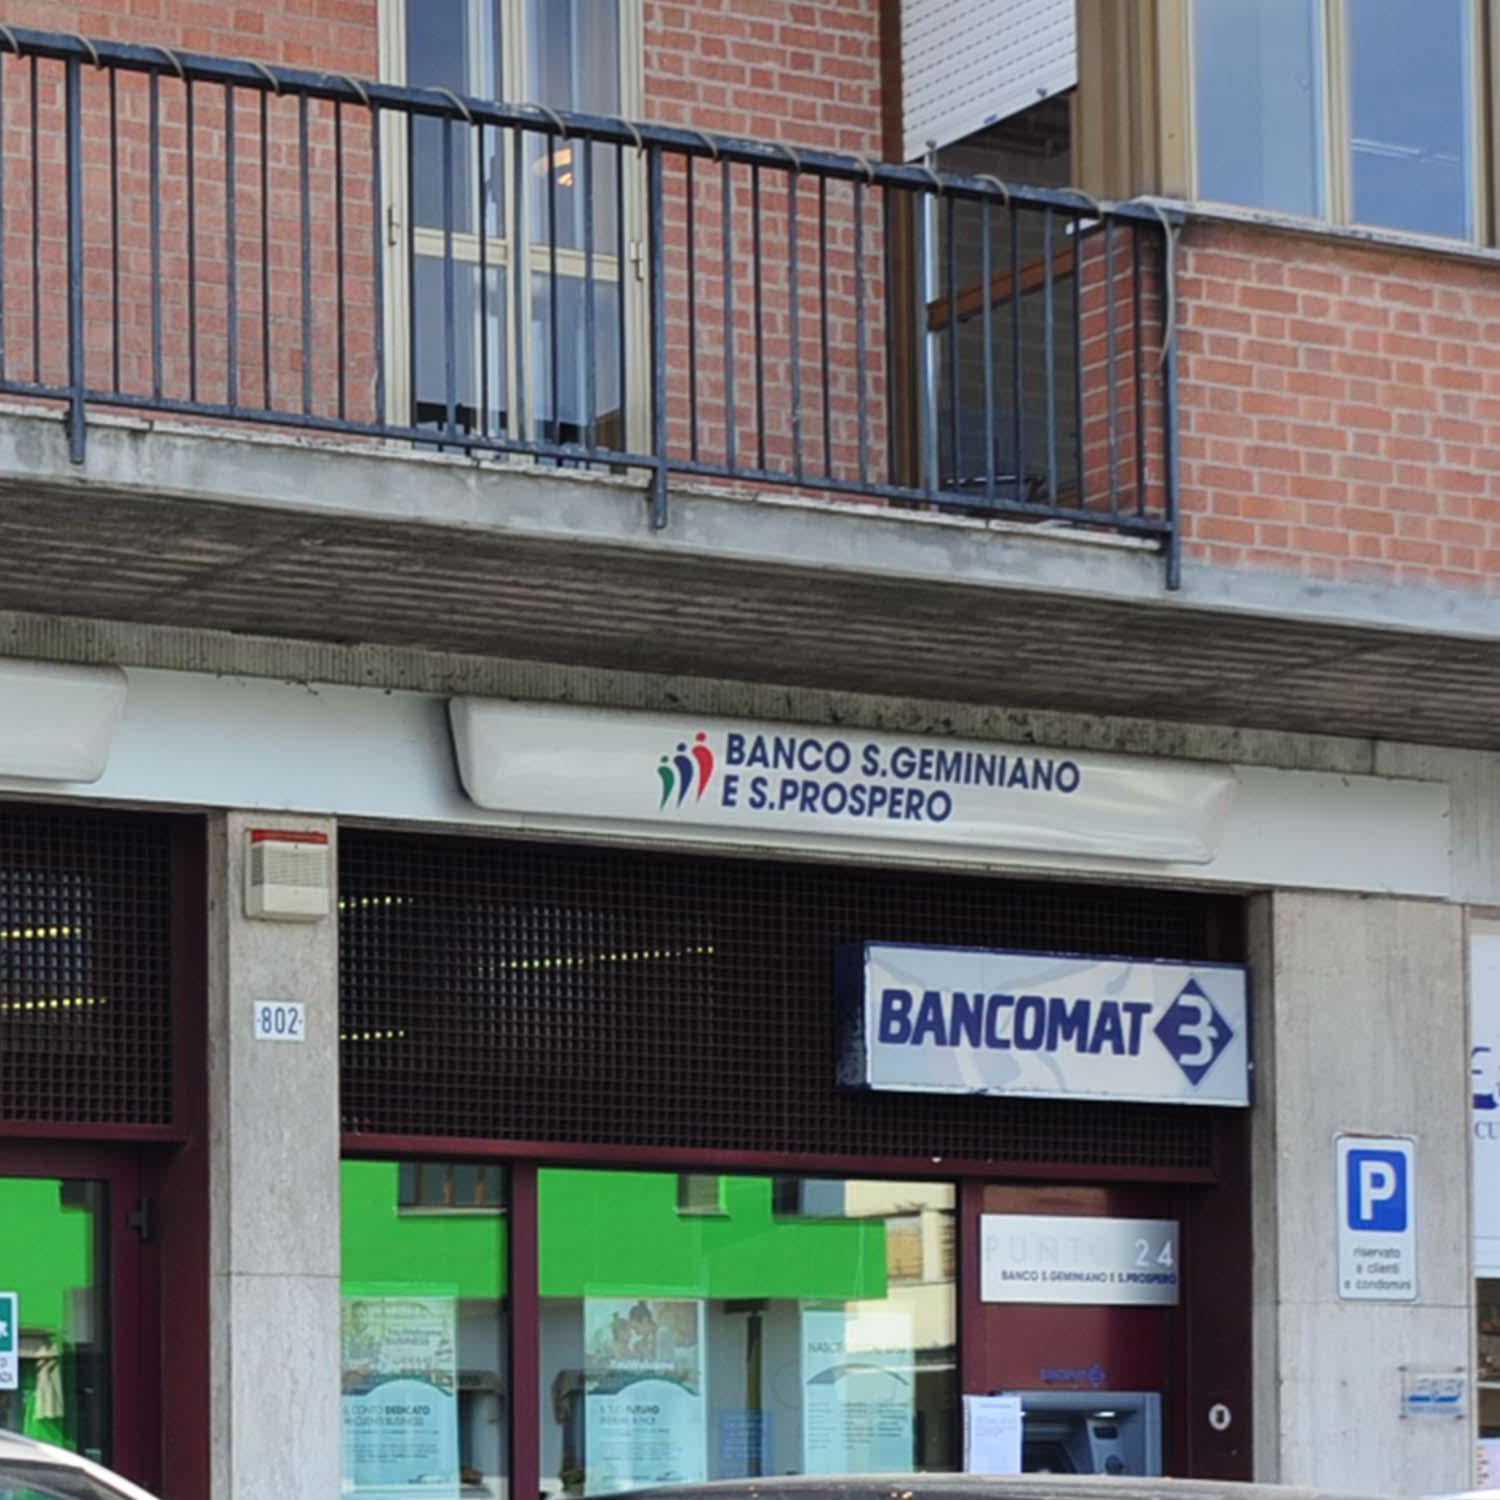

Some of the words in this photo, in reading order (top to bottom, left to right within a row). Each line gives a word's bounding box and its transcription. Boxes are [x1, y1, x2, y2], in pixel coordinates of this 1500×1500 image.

[725, 733, 851, 774] BANCO
[861, 743, 1081, 794] S.GEMINIANO
[721, 775, 738, 807] E
[748, 778, 952, 822] S.PROSPERO
[260, 1007, 299, 1036] 802
[878, 988, 1153, 1056] BANCOMAT
[1359, 1159, 1398, 1222] P
[1353, 1246, 1401, 1259] riservato
[1001, 1269, 1039, 1282] BANCO
[1367, 1262, 1399, 1275] clienti
[1355, 1278, 1412, 1291] condomini
